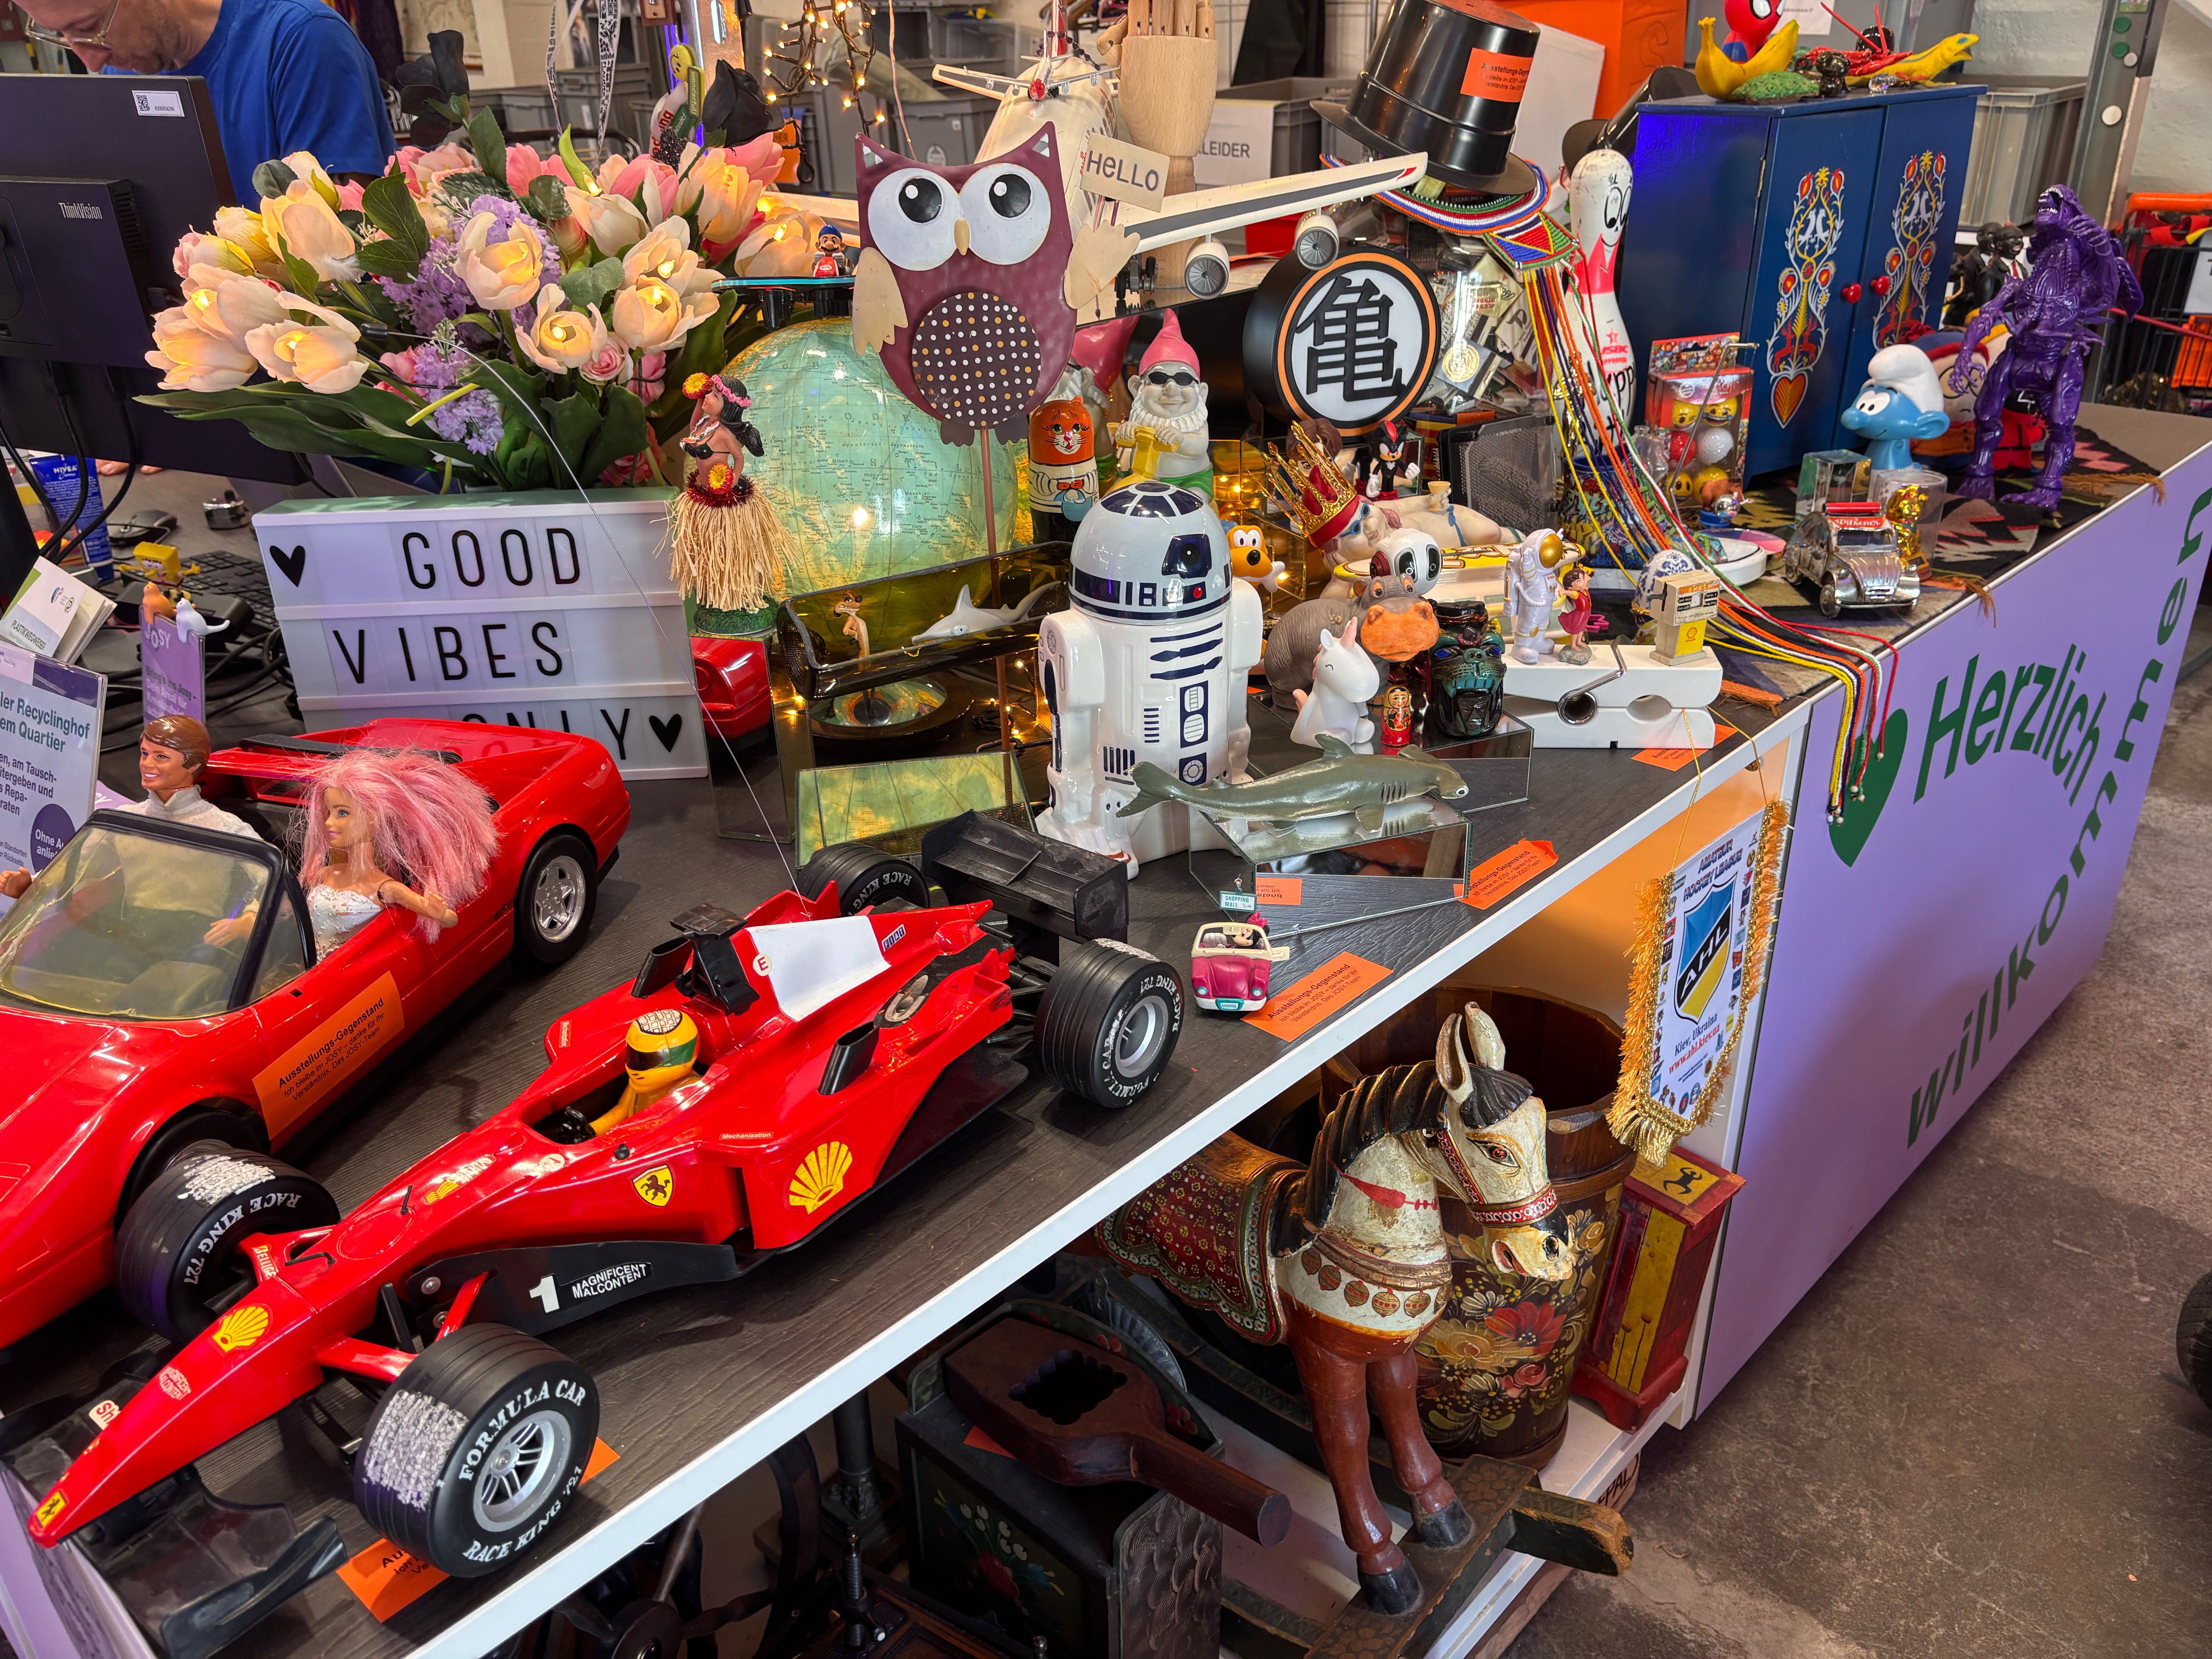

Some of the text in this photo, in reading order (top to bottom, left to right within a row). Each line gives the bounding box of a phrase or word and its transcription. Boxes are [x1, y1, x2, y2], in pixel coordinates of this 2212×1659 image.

[58, 202, 103, 220] ThinkVision
[1296, 275, 1407, 402] 亀
[53, 465, 77, 474] NIVEA
[402, 527, 580, 589] GOOD
[333, 622, 563, 684] VIBES
[17, 697, 90, 739] Recyclinghof
[19, 721, 65, 752] Quartier
[1913, 644, 2107, 805] Herzlich
[12, 758, 24, 771] am
[26, 761, 57, 783] Tausch-
[5, 783, 27, 802] Repa-
[38, 786, 53, 799] und
[4, 841, 27, 858] Standorten
[35, 829, 55, 847] Ohne
[1698, 838, 1733, 874] AMATEUR
[883, 871, 913, 886] RACE
[1469, 851, 1530, 891] sstellungs-Gegenstand
[1683, 868, 1715, 903] HOCKEY
[1714, 847, 1743, 881] LEAGUE
[852, 878, 880, 910] KING
[884, 926, 905, 950] FIAT
[757, 957, 769, 972] E
[1679, 925, 1728, 999] AHL
[1155, 975, 1177, 996] KING
[1267, 964, 1351, 1019] Ausstellungs-Gegenstand
[1290, 1004, 1304, 1016] bleibe
[1311, 990, 1326, 1002] JOSY
[1329, 978, 1343, 990] danke
[1321, 993, 1334, 1002] Das
[1333, 975, 1362, 996] JOSY-Team
[1172, 993, 1181, 1032] RACE
[279, 997, 384, 1089] Ausstellungs-Gegenstand
[1668, 1024, 1720, 1075] www.ahl.kiev.ua
[1674, 1013, 1718, 1057] Kiev, Ukraina
[284, 1087, 294, 1097] Ich
[295, 1070, 315, 1088] bleibe
[316, 1063, 324, 1072] im
[325, 1046, 342, 1064] JOSY
[349, 1027, 367, 1045] danke
[292, 1026, 381, 1101] Verständnis. Das JOSY-Team
[250, 1192, 302, 1214] RACE
[198, 1205, 245, 1254] KING
[184, 1257, 205, 1285] 727
[572, 1264, 646, 1298] MAGNIFICENT
[572, 1266, 646, 1298] MALCONTENT
[529, 1275, 560, 1313] 1
[459, 1379, 586, 1482] FORMULA CAR
[463, 1539, 512, 1563] RACE
[514, 1499, 562, 1552] KING
